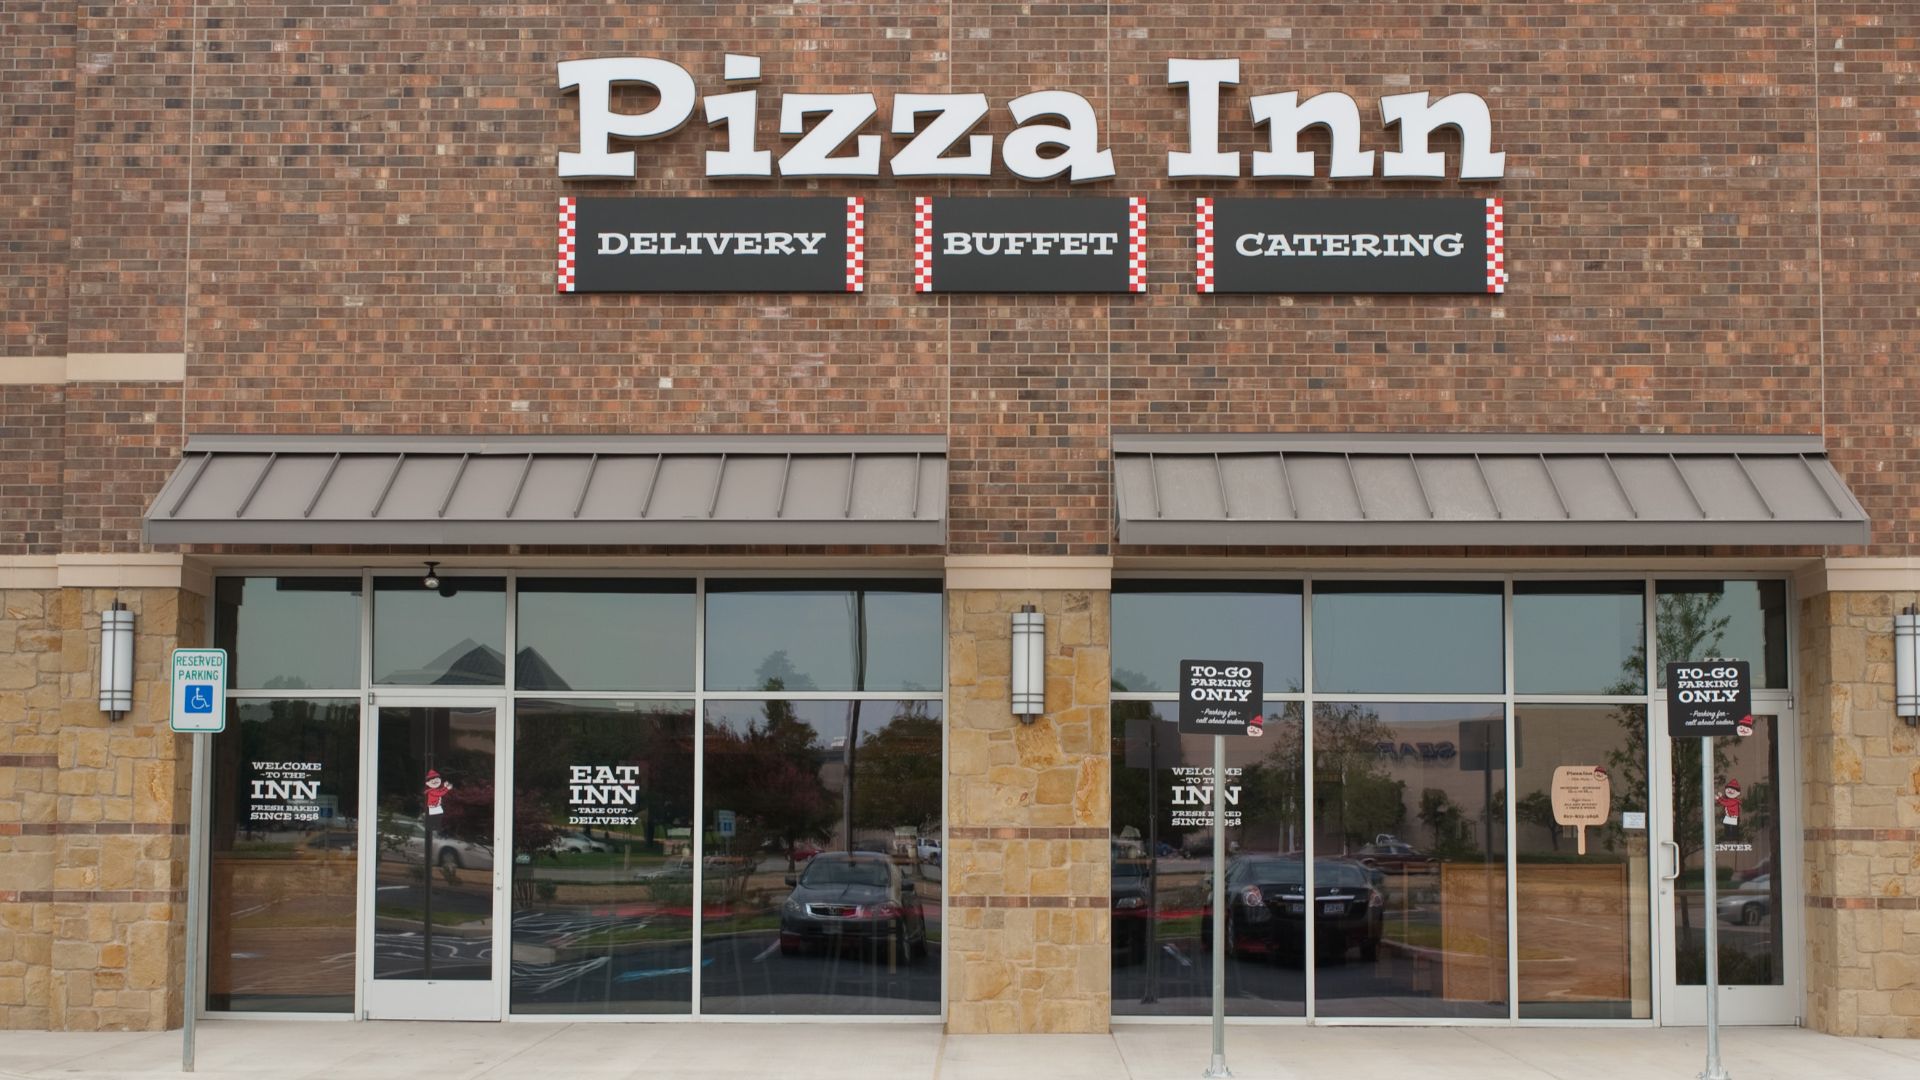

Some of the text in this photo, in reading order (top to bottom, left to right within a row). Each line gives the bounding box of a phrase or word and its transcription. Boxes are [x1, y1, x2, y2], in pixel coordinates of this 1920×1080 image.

[557, 53, 1507, 184] Pizza Inn
[597, 232, 826, 256] DELIVERY
[943, 232, 1118, 256] BUFFET
[1235, 232, 1465, 257] CATERING
[176, 655, 223, 667] RESERVED
[178, 670, 219, 681] PARKING
[1190, 665, 1252, 679] TO-GO
[1677, 667, 1738, 679] TO-GO
[1190, 678, 1252, 688] PARKING
[1677, 680, 1739, 689] PARKING
[1190, 687, 1253, 702] ONLY
[1678, 689, 1740, 703] ONLY
[252, 761, 322, 771] WELCOME
[1172, 767, 1242, 776] WELCME
[569, 765, 640, 784] EAT
[251, 780, 321, 800] INN
[569, 785, 640, 805] INN
[250, 804, 285, 812] FRESH
[250, 812, 319, 821] SINCE 1958
[569, 816, 639, 825] DELIVERY
[1172, 818, 1214, 826] SINCE
